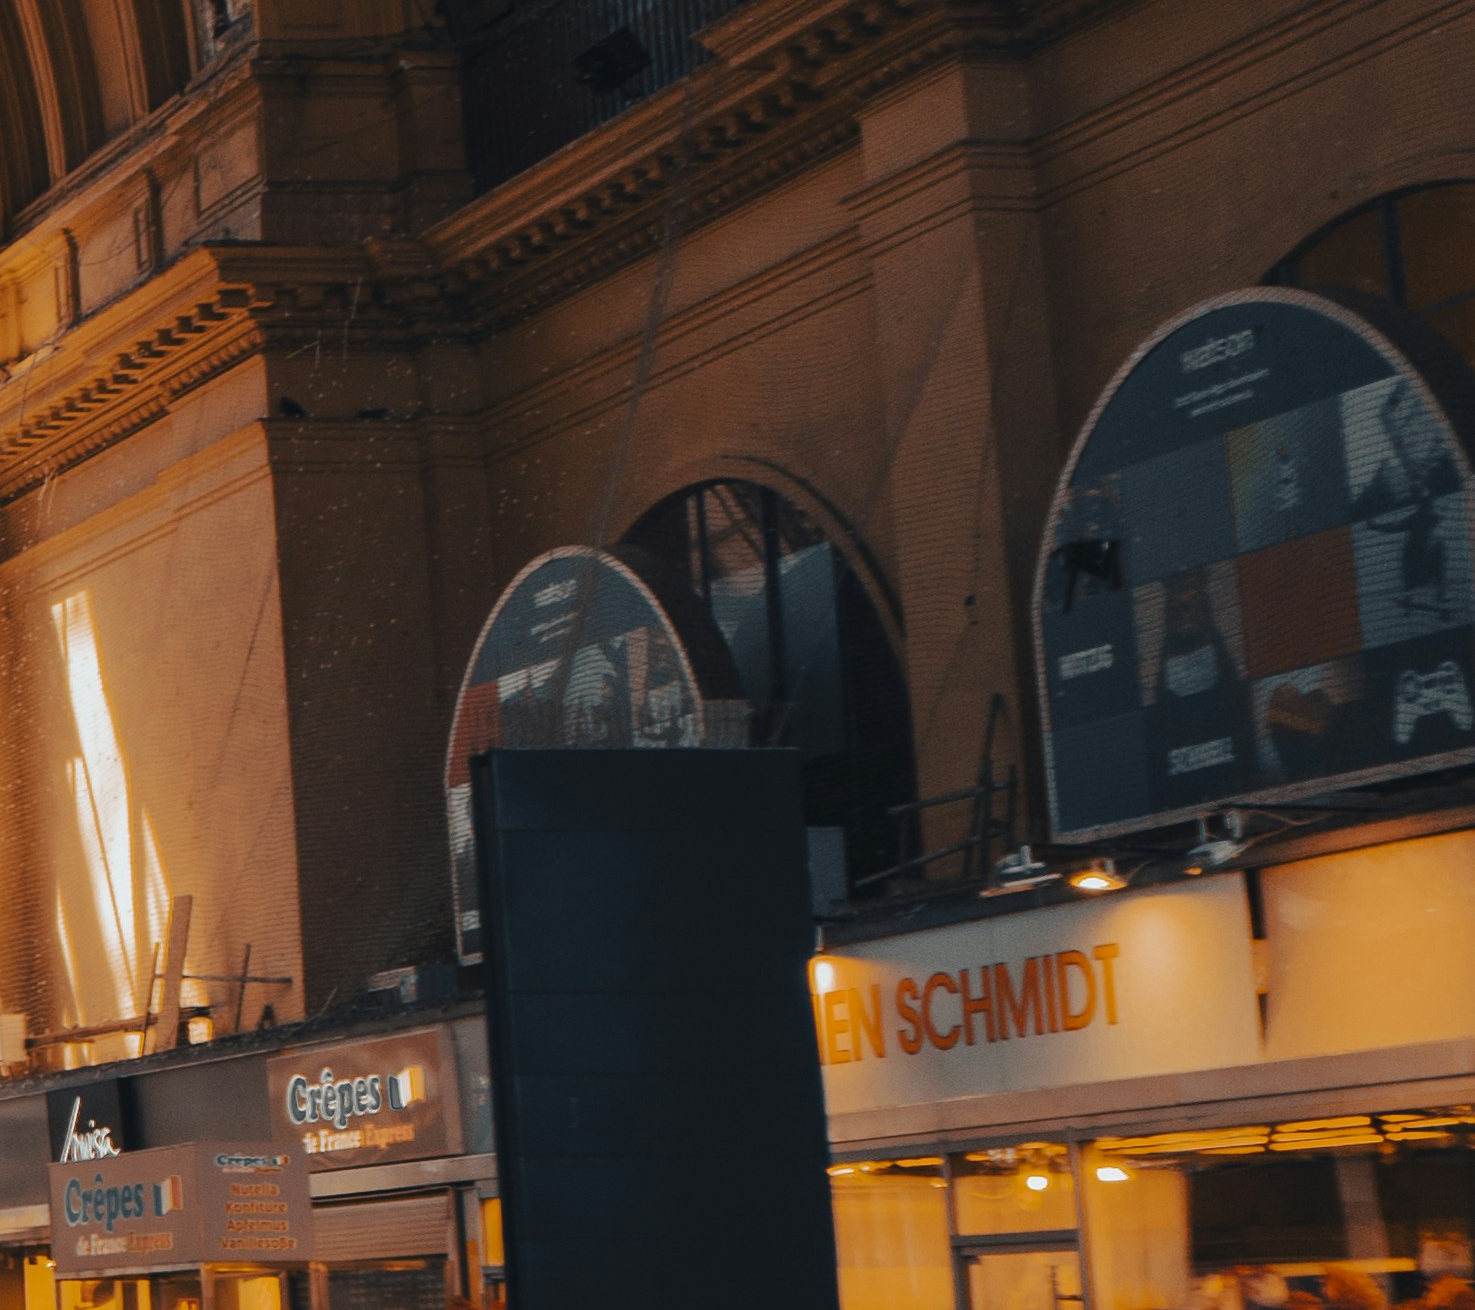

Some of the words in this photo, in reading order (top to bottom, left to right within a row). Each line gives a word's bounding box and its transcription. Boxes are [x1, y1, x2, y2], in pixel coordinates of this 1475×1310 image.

[897, 943, 1120, 1057] SCHMIDT
[287, 1068, 381, 1130] Crêpes
[65, 1174, 145, 1232] Crêpes
[231, 1184, 278, 1196] Nutella
